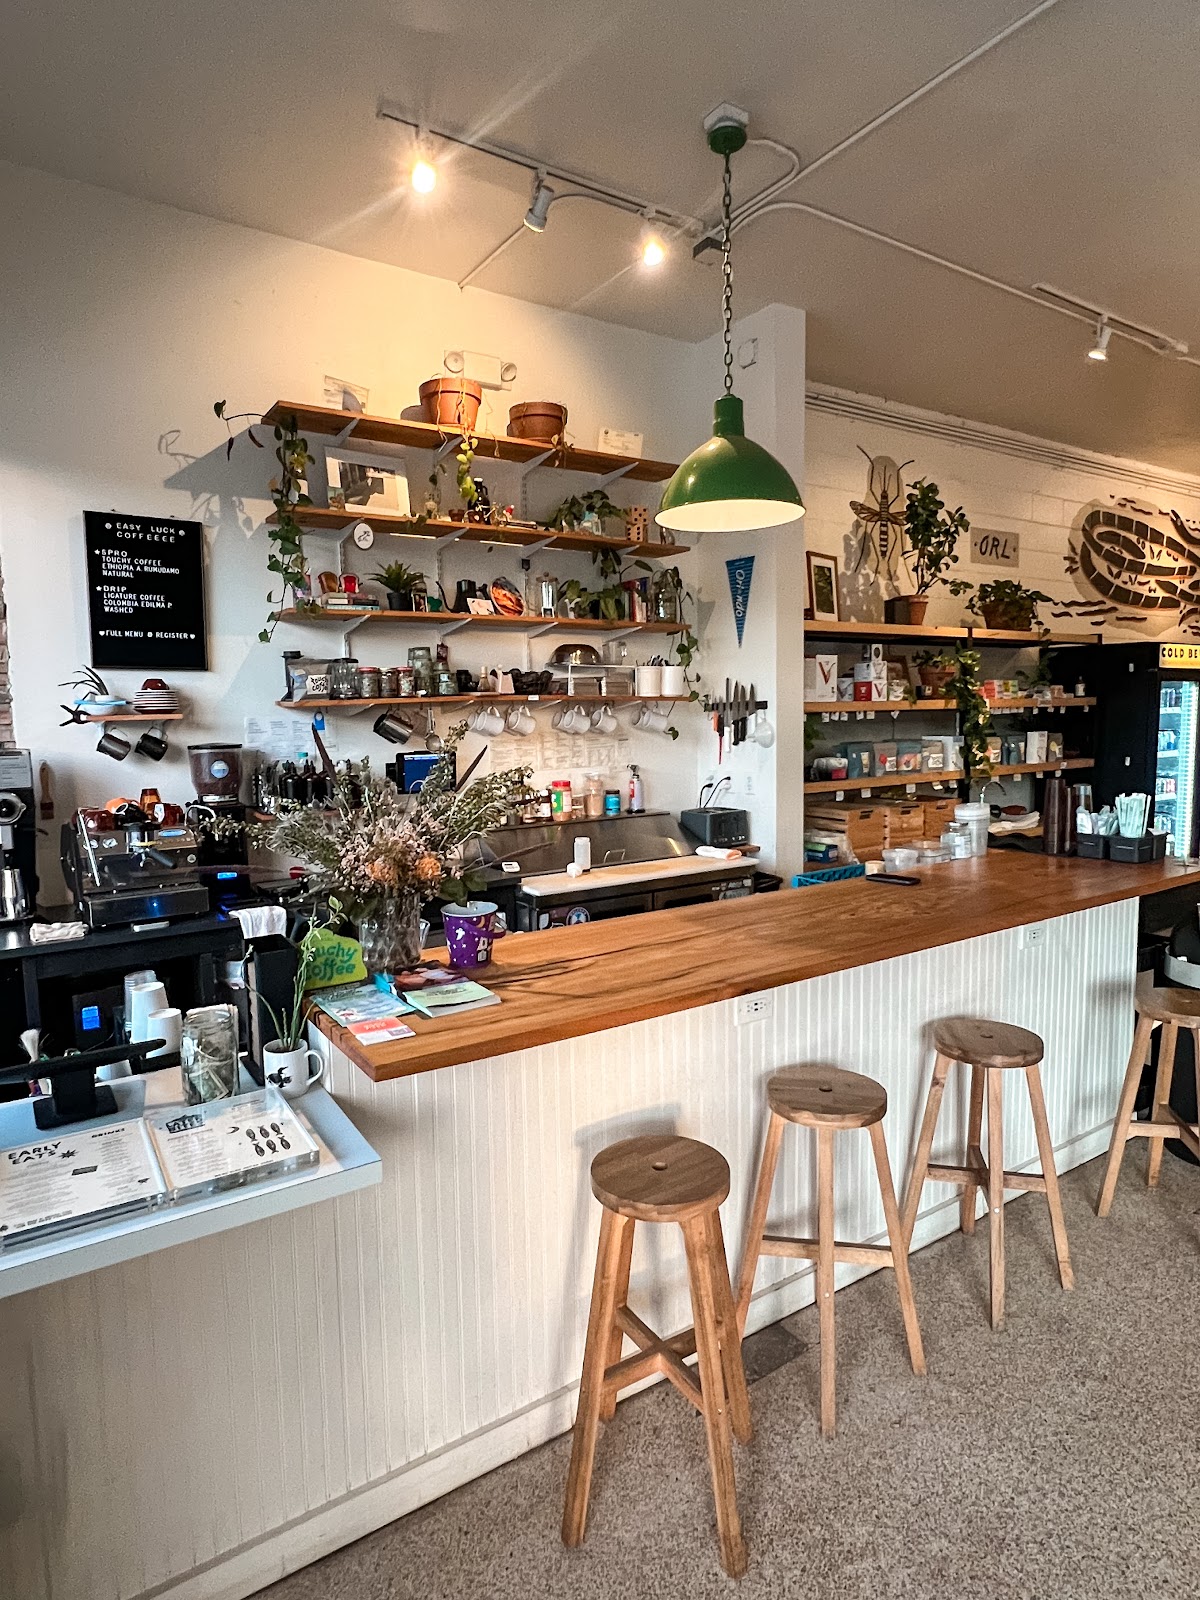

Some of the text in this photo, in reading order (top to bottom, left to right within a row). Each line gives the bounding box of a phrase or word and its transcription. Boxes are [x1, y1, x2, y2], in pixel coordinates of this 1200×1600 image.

[116, 522, 175, 534] EASY LUCK
[116, 531, 175, 543] COFFEEEE
[101, 549, 128, 557] SPRO
[102, 556, 131, 564] TOUCHY
[102, 563, 134, 571] ETHIOPIA
[102, 570, 135, 578] NATURAL
[103, 592, 137, 600] LIGATURE
[735, 569, 745, 617] Orlndo
[103, 599, 139, 607] COLOMBIA
[1161, 647, 1185, 658] COLD
[311, 942, 358, 963] uchy
[8, 1141, 62, 1160] EARLY
[12, 1150, 57, 1165] EATS
